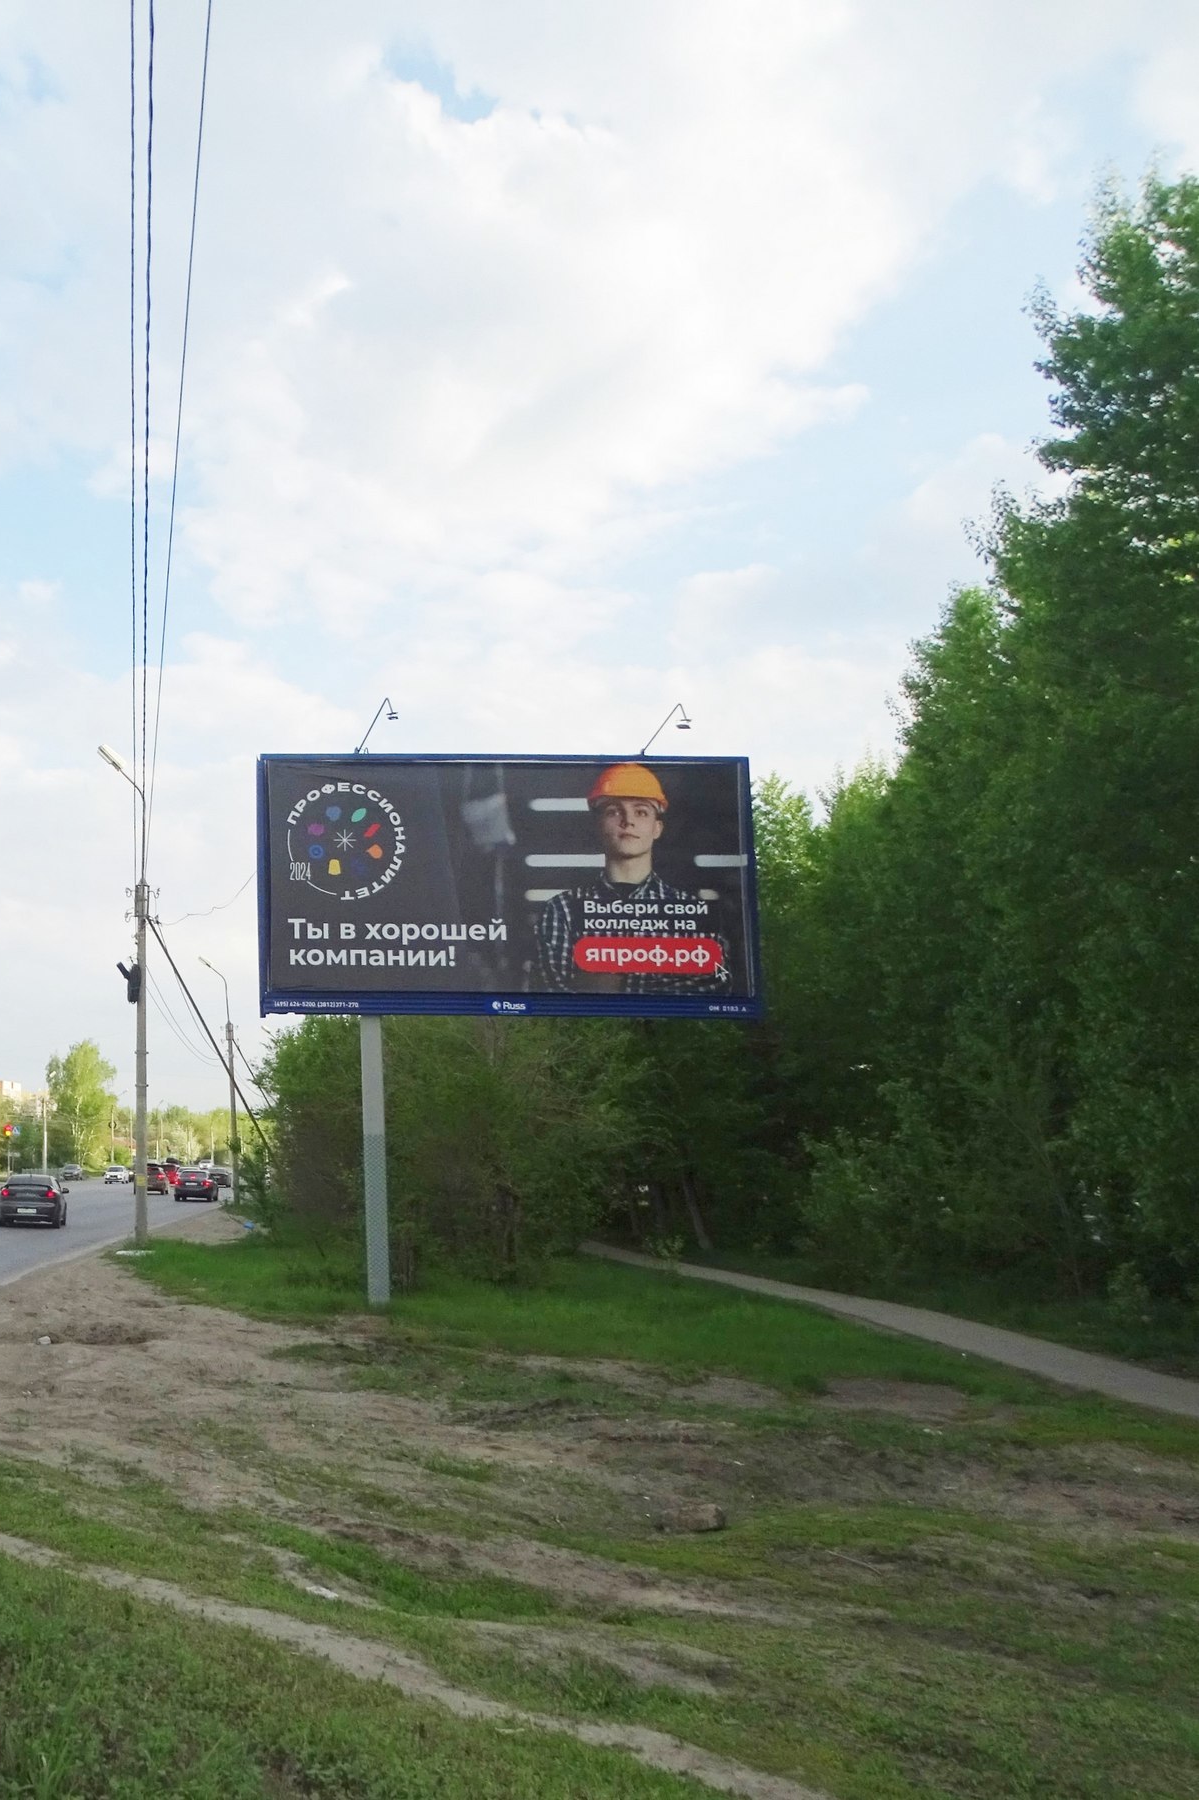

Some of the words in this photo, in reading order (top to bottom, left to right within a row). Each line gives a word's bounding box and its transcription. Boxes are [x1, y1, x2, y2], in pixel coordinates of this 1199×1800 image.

[287, 782, 406, 900] ПРОФЕССИОНАЛИТЕТ
[289, 862, 312, 881] 2024
[583, 900, 659, 917] Выбери
[663, 901, 709, 915] свой
[287, 918, 329, 939] Ты
[339, 921, 356, 940] в
[364, 918, 508, 945] хорошей
[584, 918, 669, 932] колледж
[674, 919, 697, 931] на
[289, 945, 456, 967] компании!
[585, 944, 711, 968] япроф.рф
[502, 1001, 526, 1010] Russ
